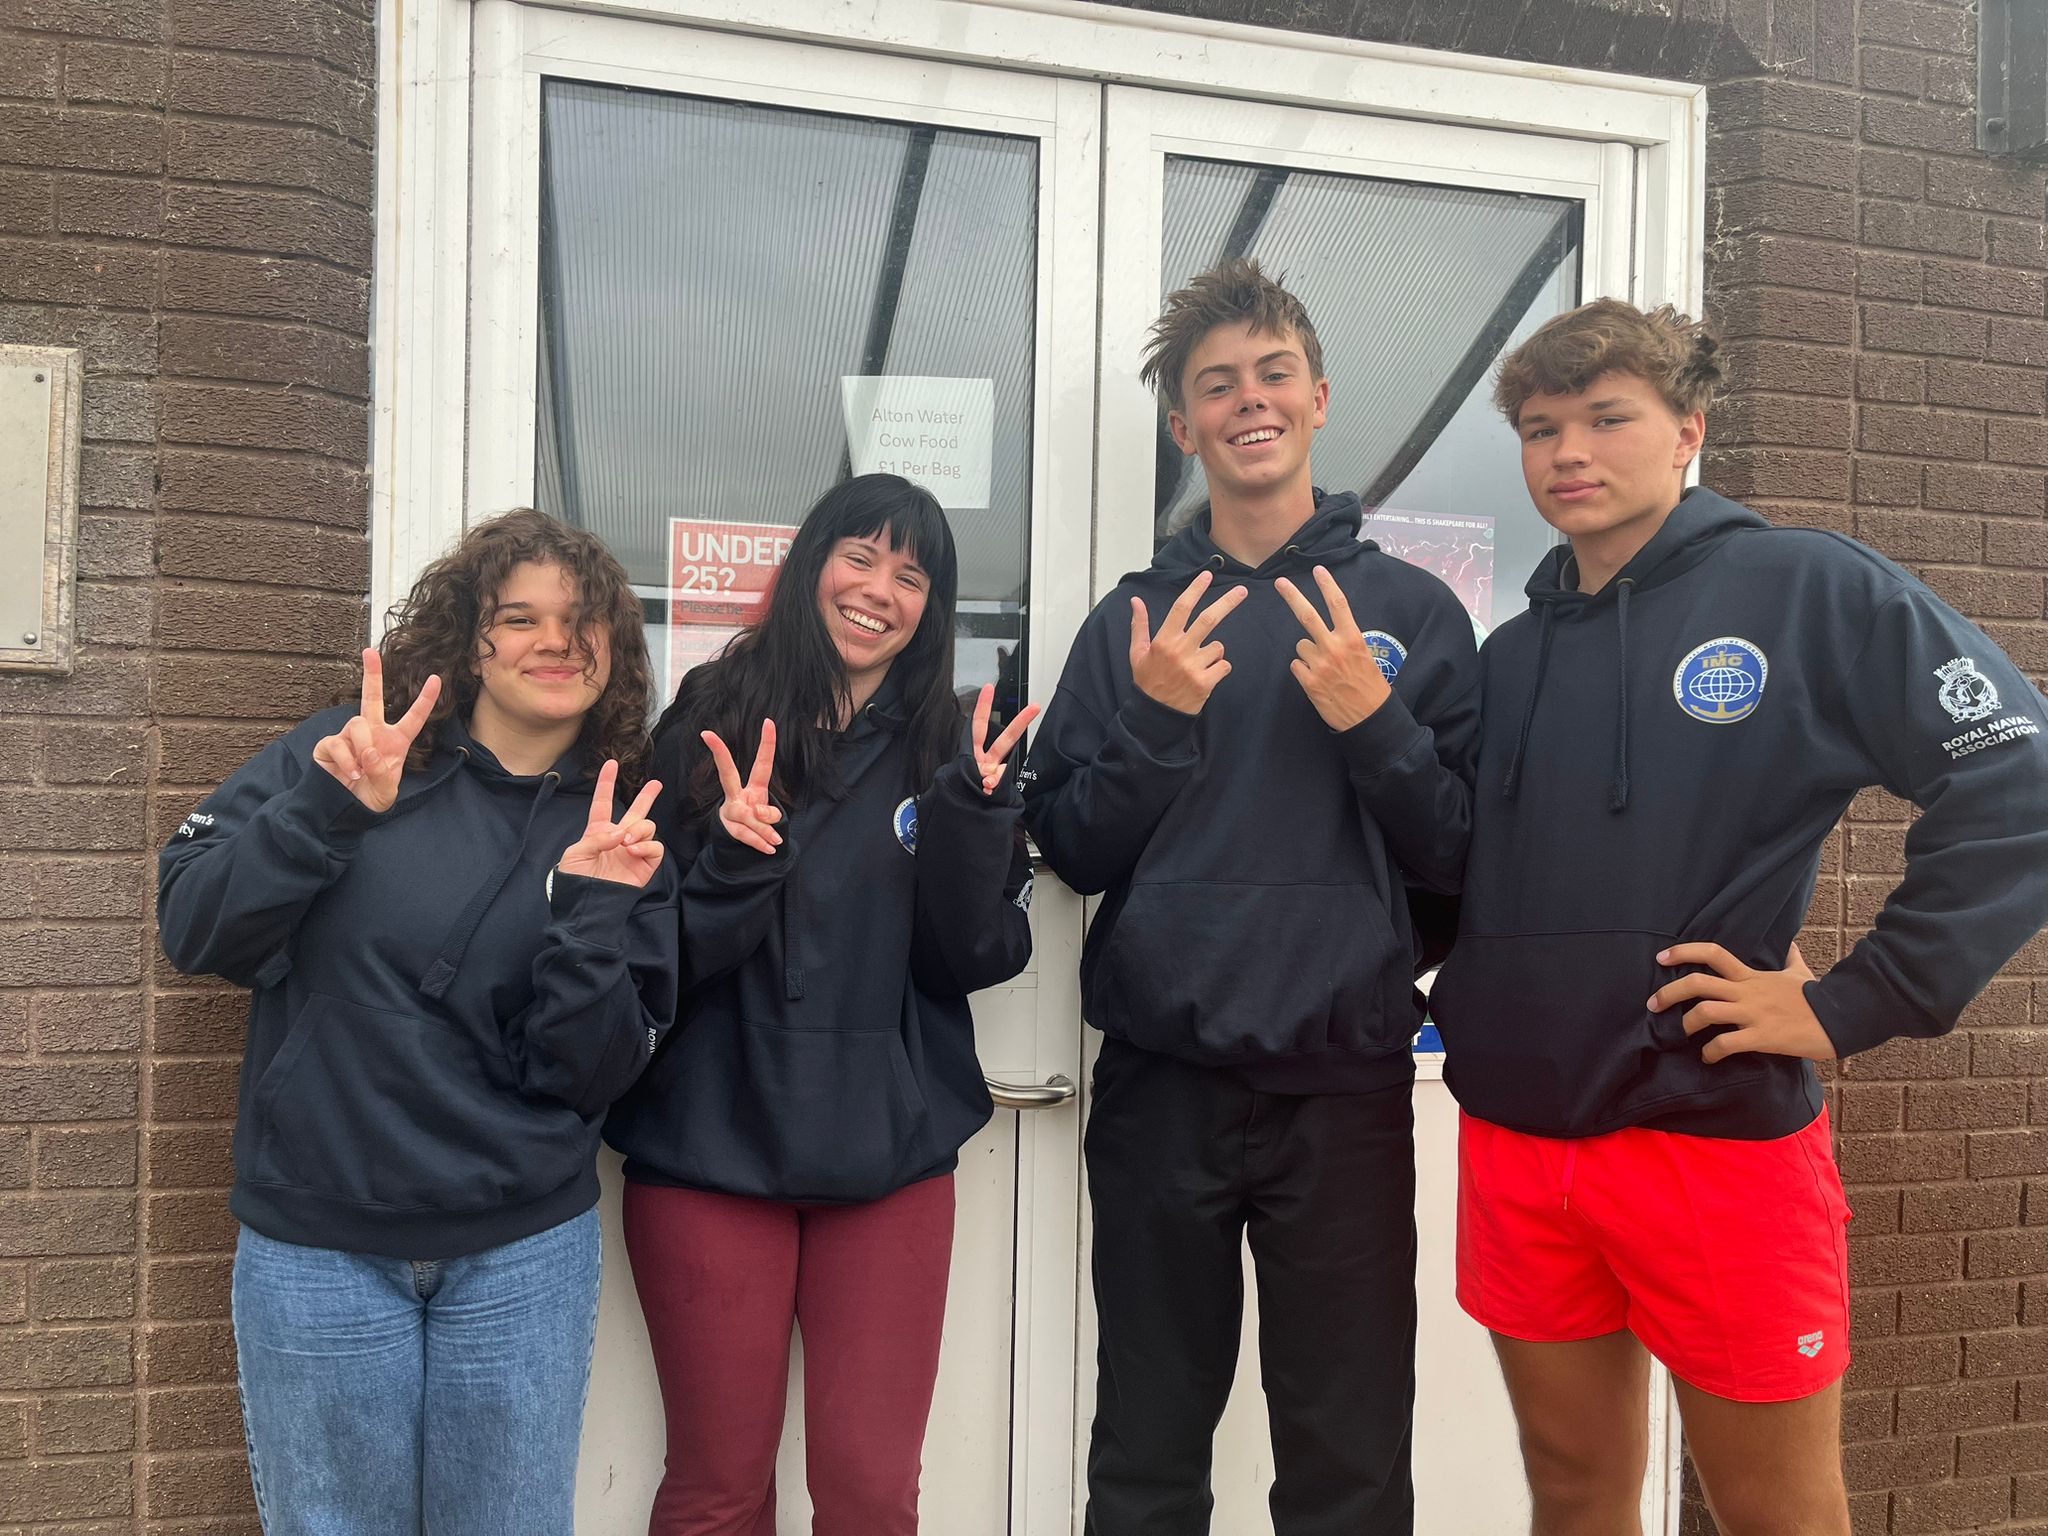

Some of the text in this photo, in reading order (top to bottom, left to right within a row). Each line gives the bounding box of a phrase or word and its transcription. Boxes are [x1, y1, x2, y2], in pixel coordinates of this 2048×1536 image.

[872, 408, 964, 424] Alton Water
[879, 433, 958, 449] Cow Food
[879, 461, 961, 479] £1 Per Bag
[682, 532, 793, 566] UNDER
[681, 565, 736, 597] 25?
[1702, 655, 1743, 669] IMC
[1942, 716, 2033, 751] ROYAL NAVAL
[1951, 725, 2040, 760] ASSOCIATION
